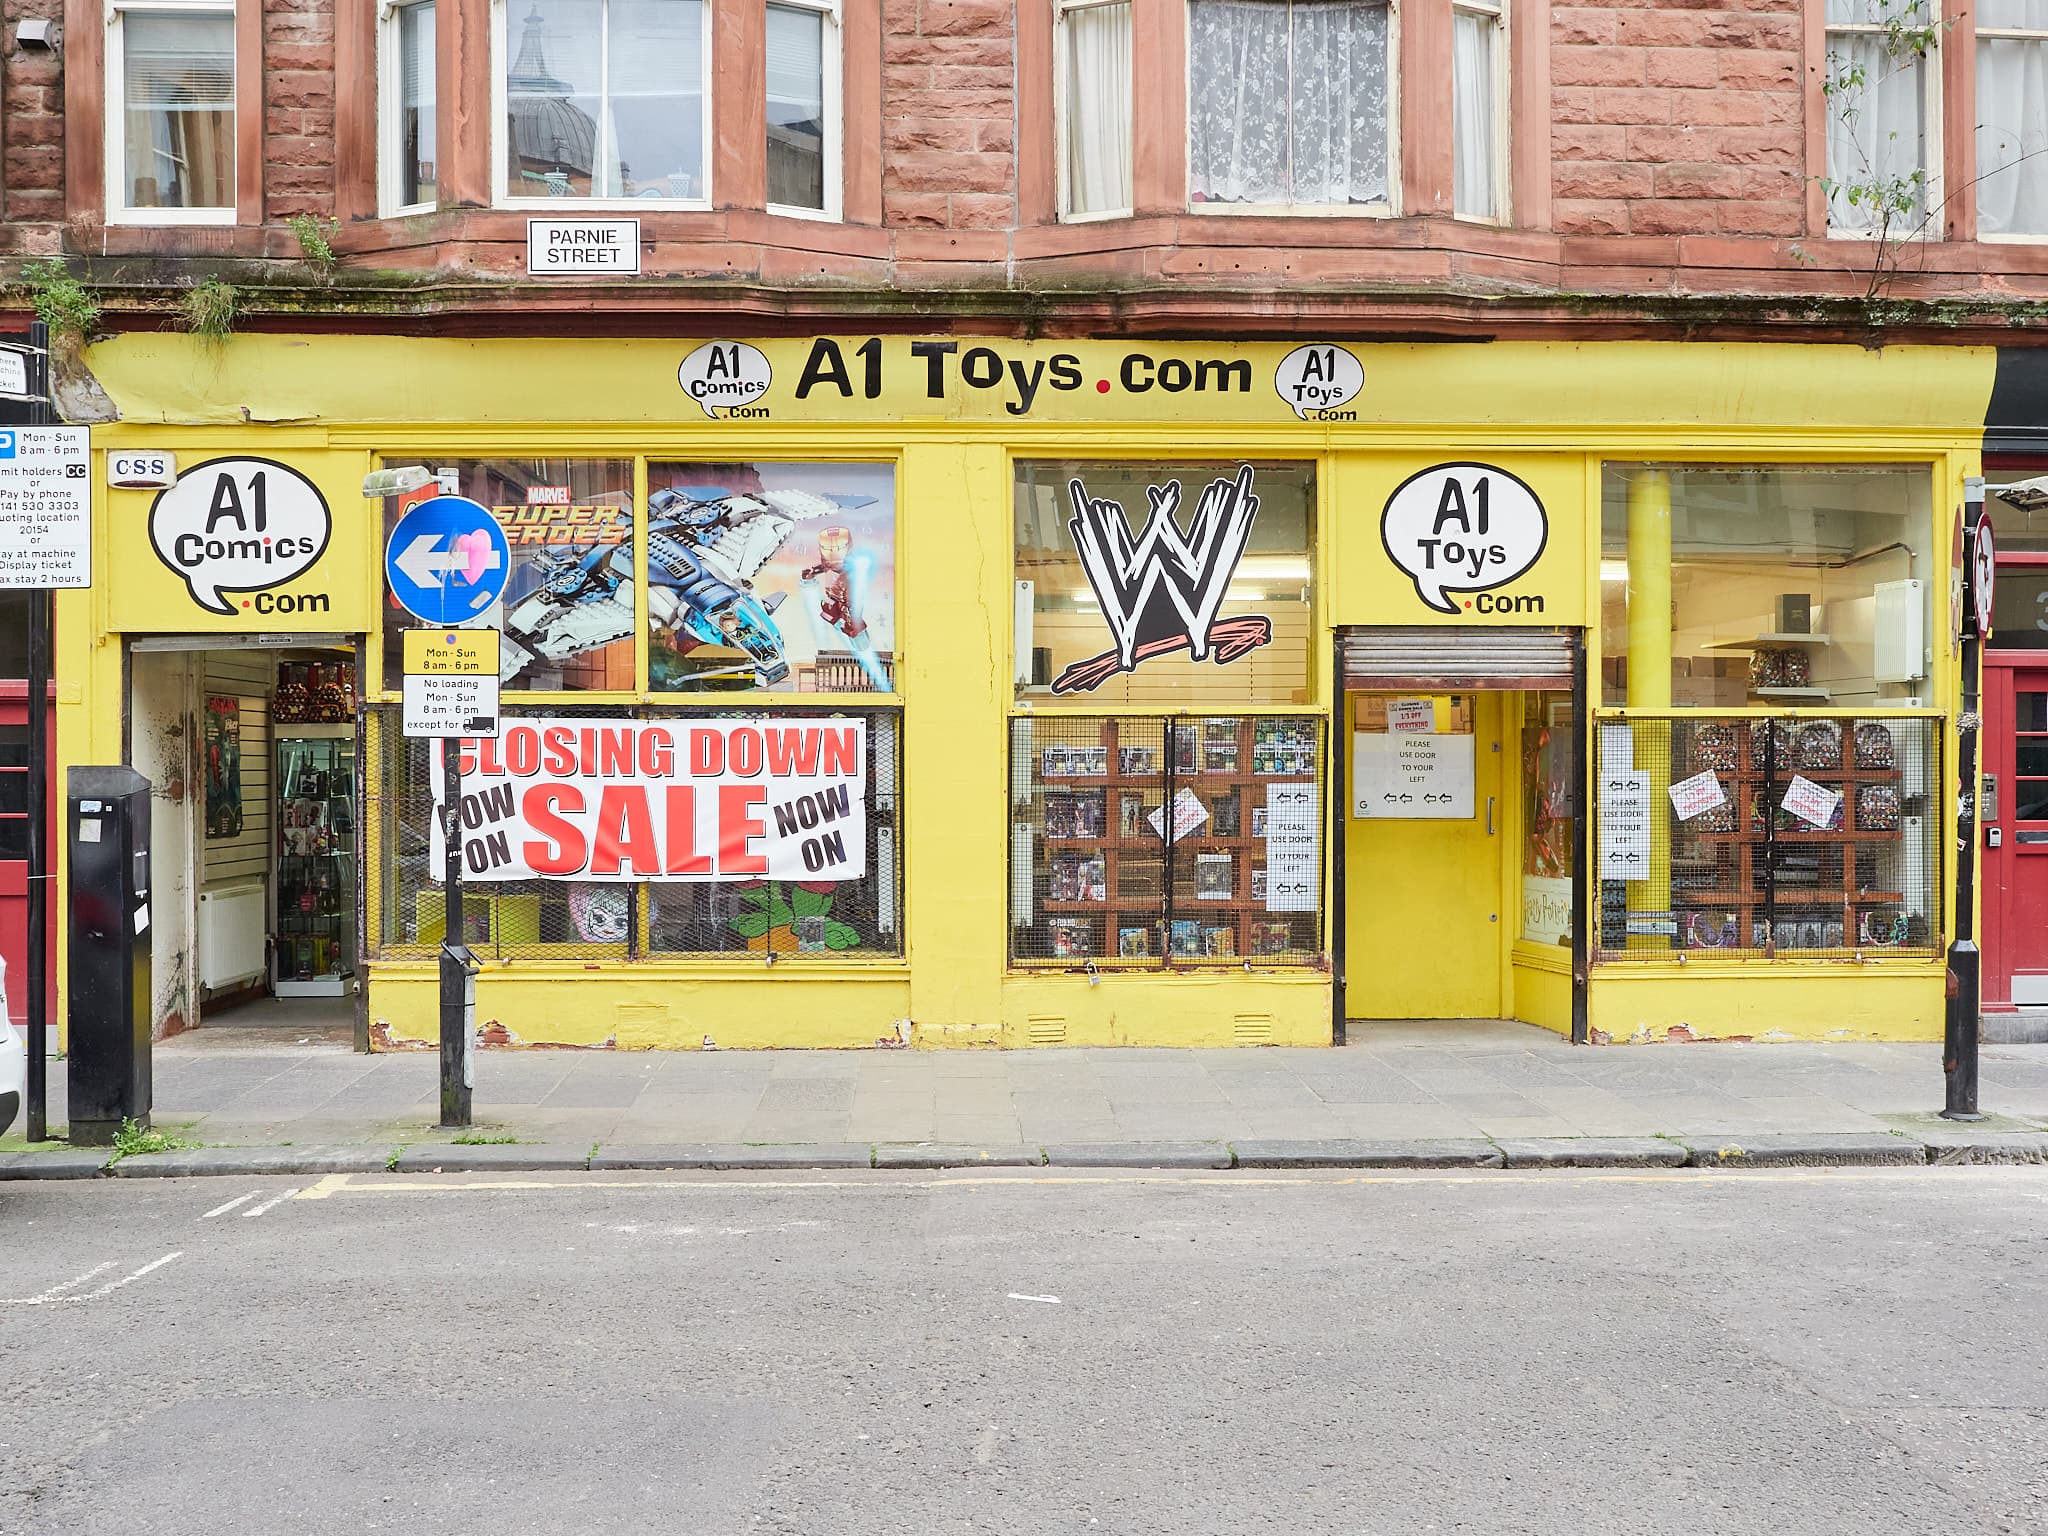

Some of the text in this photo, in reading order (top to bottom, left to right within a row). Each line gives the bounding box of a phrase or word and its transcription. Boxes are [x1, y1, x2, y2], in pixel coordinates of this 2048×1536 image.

[550, 229, 617, 244] PARNIE
[547, 248, 621, 263] STREET
[706, 345, 740, 379] A1
[795, 337, 882, 399] A1
[1301, 348, 1335, 383] A1
[691, 379, 765, 398] Comics
[1292, 384, 1344, 405] Toys
[23, 433, 46, 442] Mon
[55, 432, 76, 442] Sun
[20, 446, 27, 455] 8
[29, 447, 45, 455] am
[54, 446, 61, 455] 6
[63, 447, 80, 455] pm
[1, 467, 18, 476] mit
[22, 467, 62, 476] holders
[0, 489, 72, 499] Pay by phone
[528, 487, 570, 504] MARVEL
[1, 502, 79, 511] 141 530 3303
[205, 471, 267, 534] A1
[1432, 476, 1489, 535] A1
[36, 514, 80, 522] location
[491, 505, 620, 525] SUPER
[20, 525, 49, 535] 20154
[503, 525, 626, 545] EROES
[0, 549, 76, 560] ay at machine
[174, 533, 314, 567] Comics
[0, 560, 72, 571] Display ticket
[1417, 538, 1506, 578] Toys
[15, 575, 37, 585] stay
[41, 574, 48, 583] 2
[51, 574, 82, 583] hours
[426, 648, 448, 657] Mon
[456, 648, 476, 657] Sun
[423, 661, 430, 669] 8
[455, 661, 462, 669] 6
[464, 663, 479, 671] pm
[424, 680, 479, 689] No loading
[426, 693, 448, 701] Mon
[456, 693, 476, 702] Sun
[423, 705, 430, 713] 8
[455, 705, 462, 713] 6
[464, 707, 479, 715] pm
[407, 721, 441, 729] except
[690, 727, 857, 778] DOWN
[773, 783, 851, 838] NOW
[1359, 800, 1368, 809] G
[522, 782, 769, 876] SALE
[465, 830, 512, 874] ON
[801, 830, 847, 873] ON
